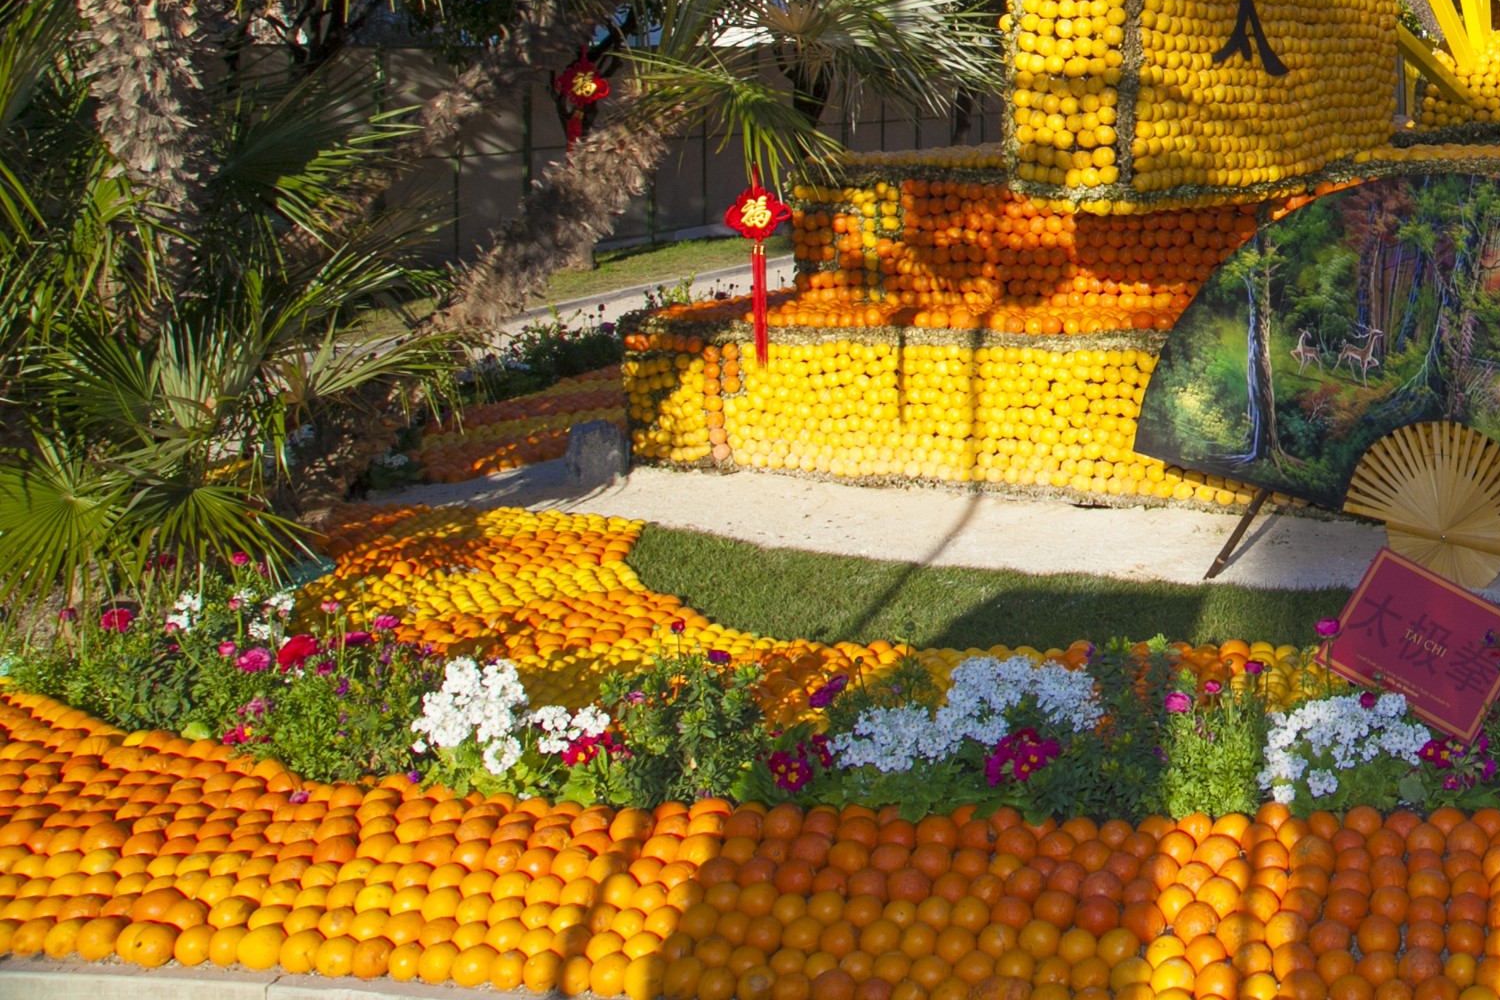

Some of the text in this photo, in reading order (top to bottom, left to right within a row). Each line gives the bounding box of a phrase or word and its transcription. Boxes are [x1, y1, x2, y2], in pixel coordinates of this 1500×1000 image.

[571, 71, 597, 97] 福
[741, 195, 772, 228] 福
[1405, 628, 1447, 658] TAI CHI
